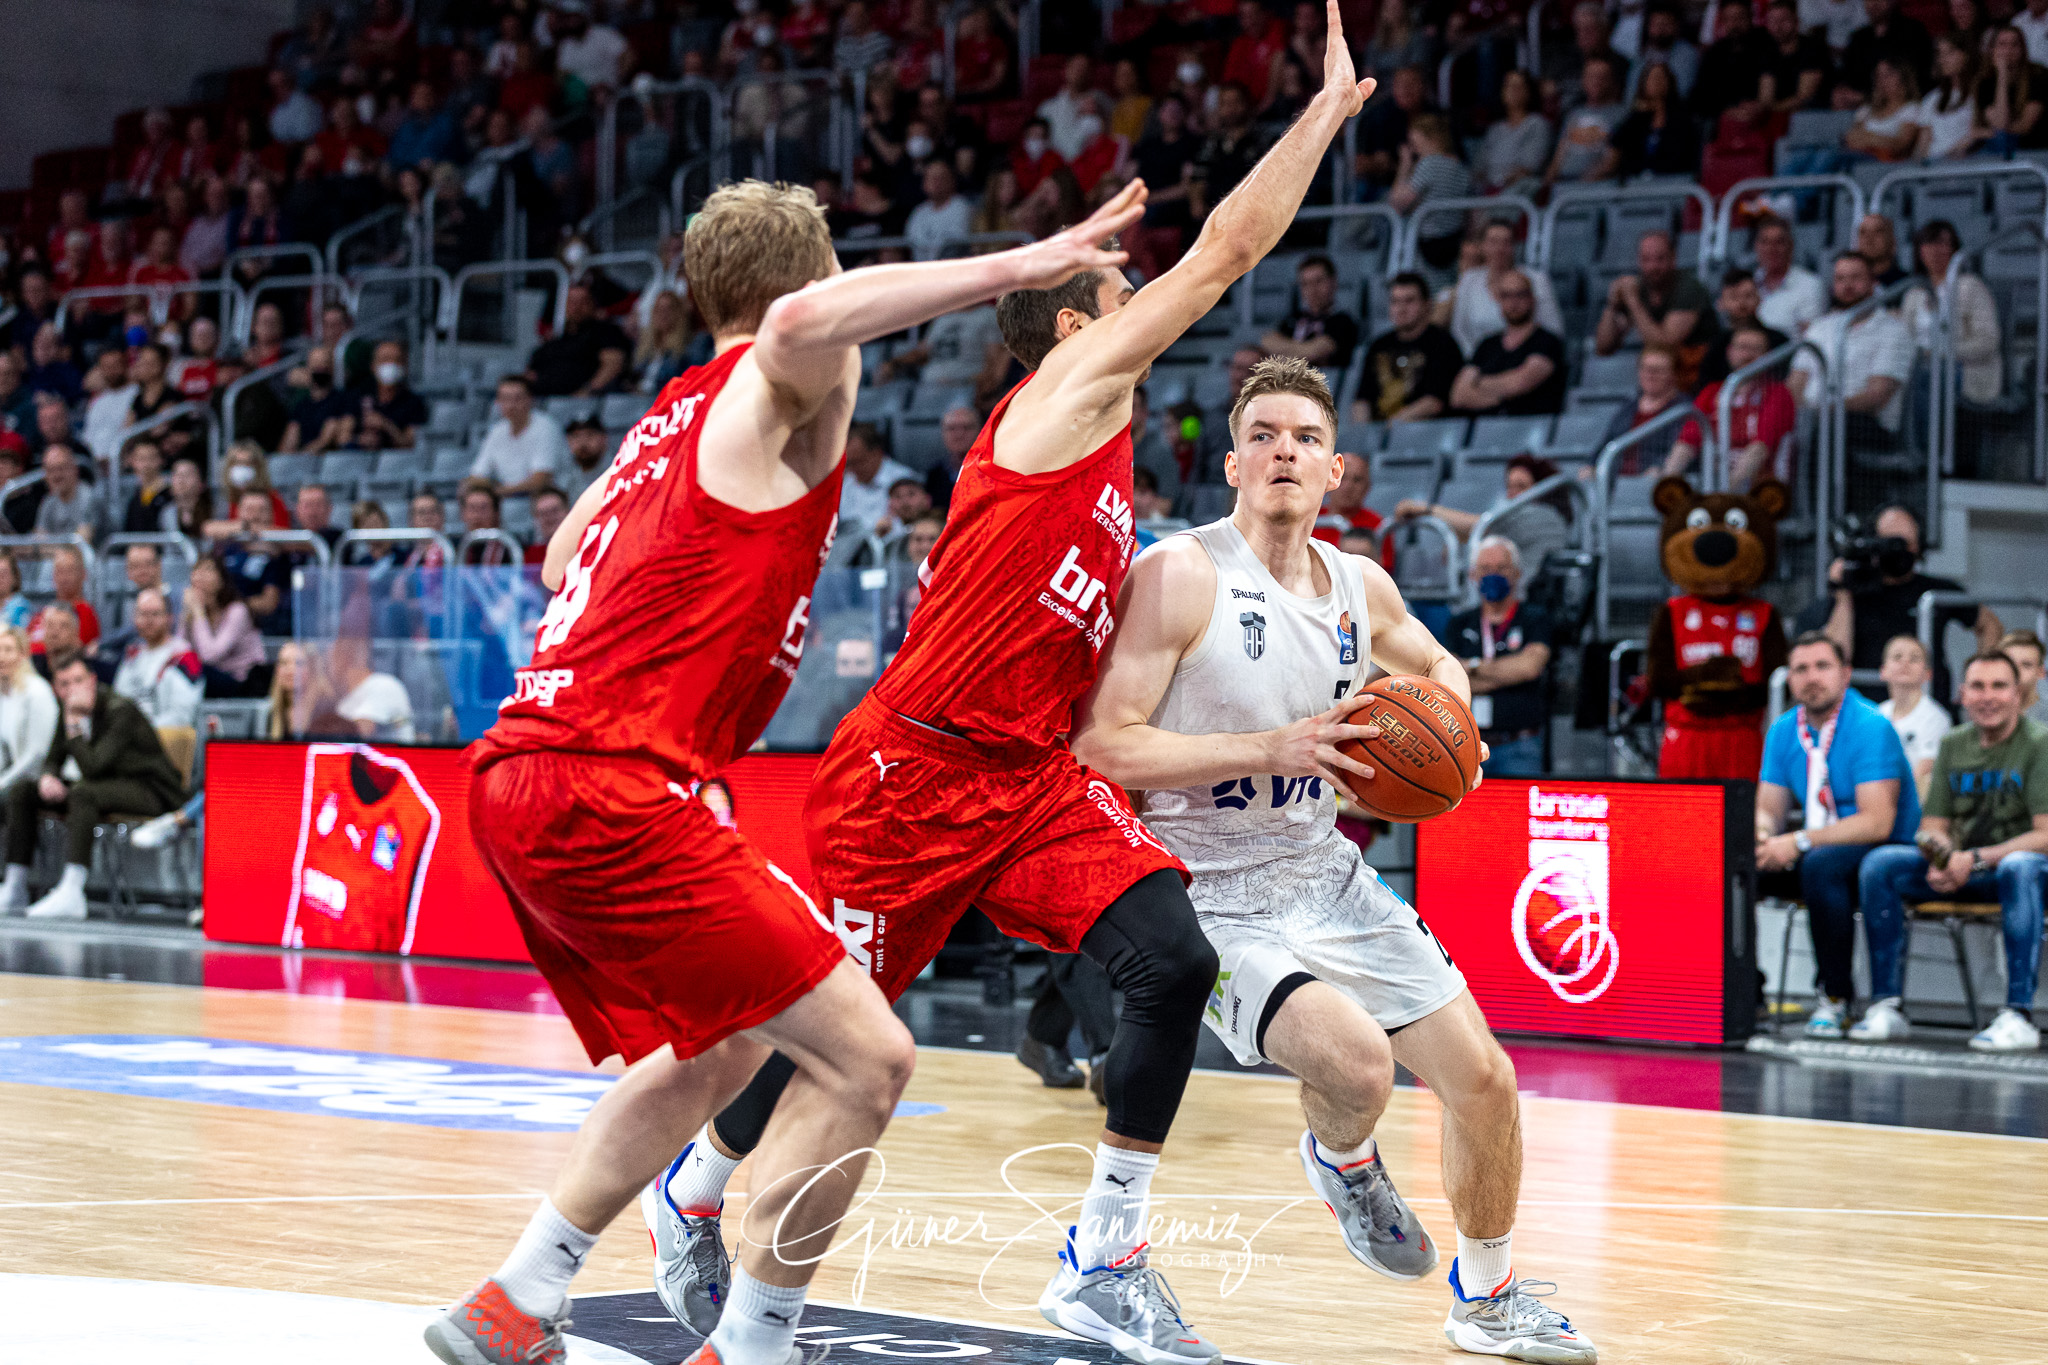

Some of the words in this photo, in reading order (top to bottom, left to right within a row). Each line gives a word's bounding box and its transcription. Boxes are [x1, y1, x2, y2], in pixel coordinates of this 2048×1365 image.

[1231, 588, 1266, 603] SPALDING
[1384, 679, 1469, 749] SPALDING
[1368, 705, 1442, 765] LEGACY
[877, 913, 886, 935] car
[875, 948, 884, 973] rent
[1230, 995, 1242, 1035] SPALDING
